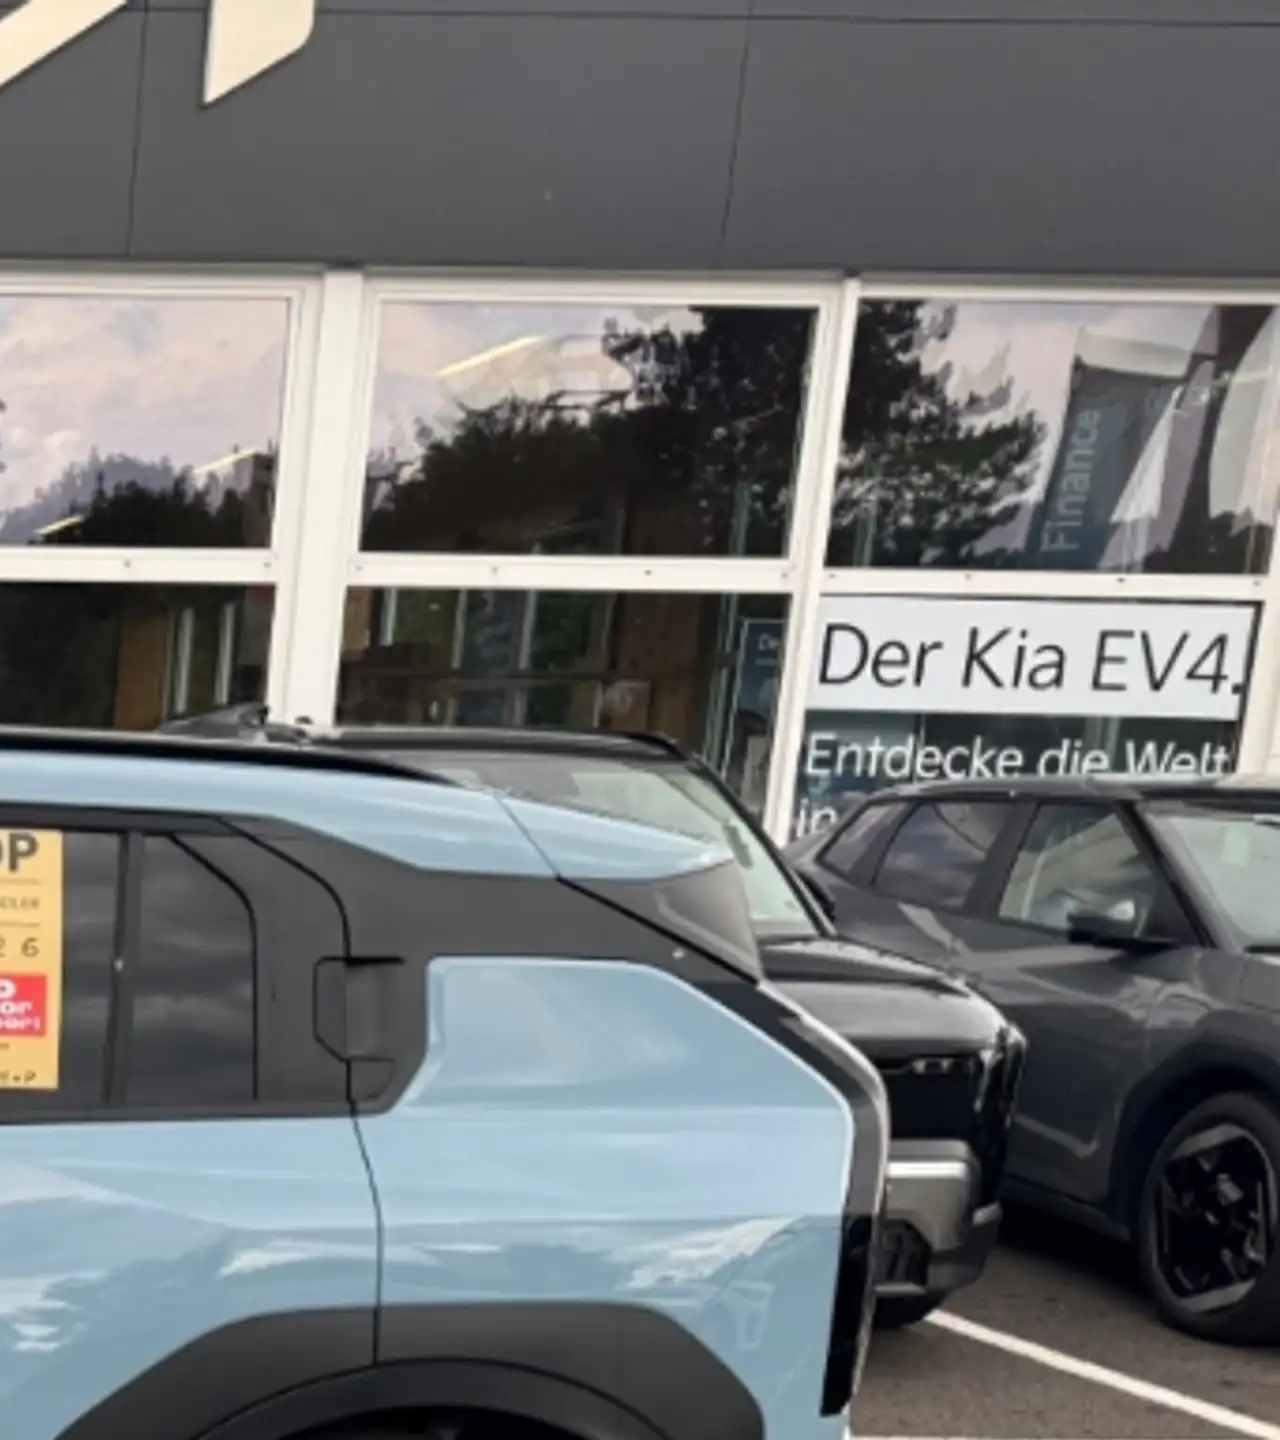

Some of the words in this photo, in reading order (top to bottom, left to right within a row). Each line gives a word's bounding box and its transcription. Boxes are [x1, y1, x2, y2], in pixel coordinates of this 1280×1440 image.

[1042, 409, 1101, 552] Finance
[819, 622, 944, 688] Der
[961, 626, 1066, 691] Kia
[1091, 629, 1243, 695] EV4.
[805, 733, 1023, 779] Entdecke
[1040, 739, 1109, 777] die
[1126, 741, 1233, 777] Welt
